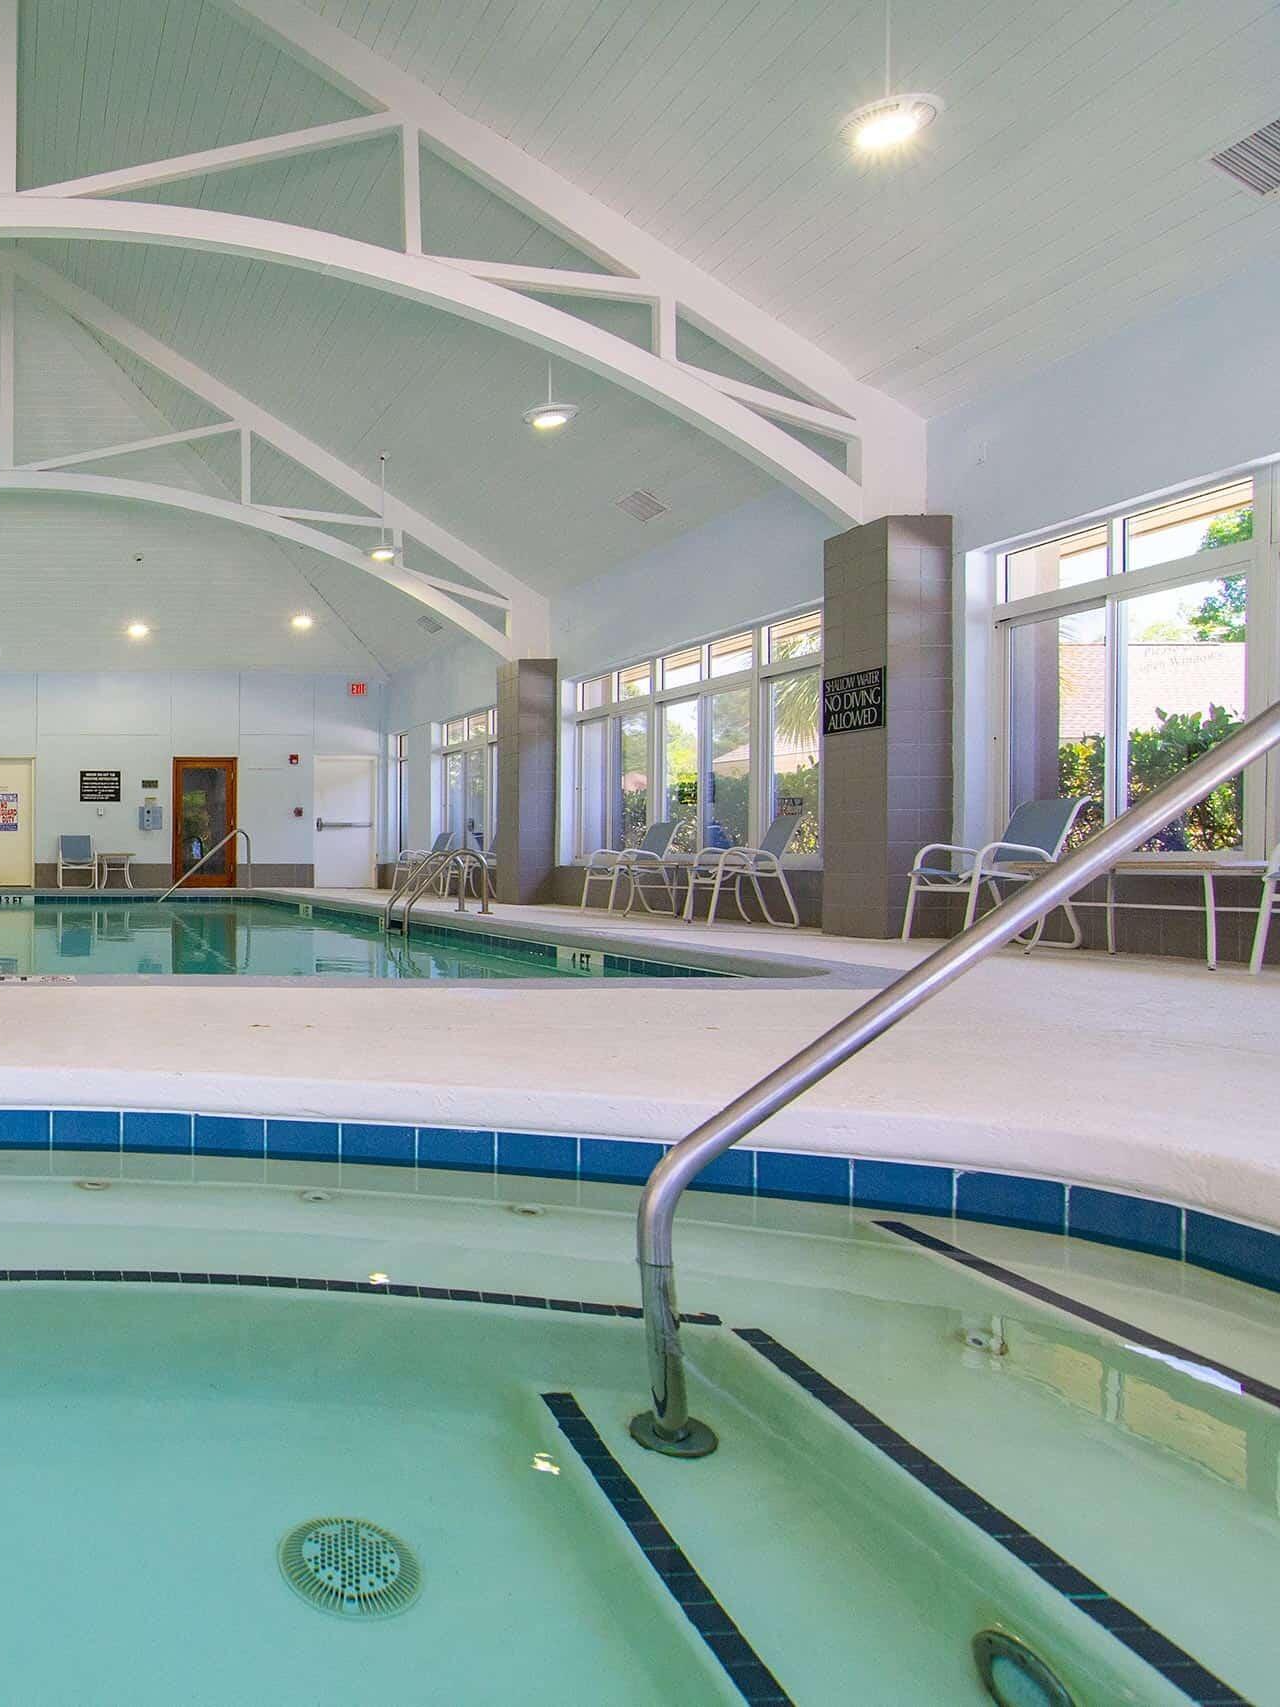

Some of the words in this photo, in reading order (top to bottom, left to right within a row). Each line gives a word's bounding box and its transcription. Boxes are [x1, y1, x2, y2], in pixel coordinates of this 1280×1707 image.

[825, 675, 857, 693] SHALLOW
[857, 670, 880, 687] WATER
[825, 694, 841, 713] NO
[843, 687, 881, 709] DIVING
[828, 707, 878, 731] ALLOWED
[2, 816, 15, 824] DUTY
